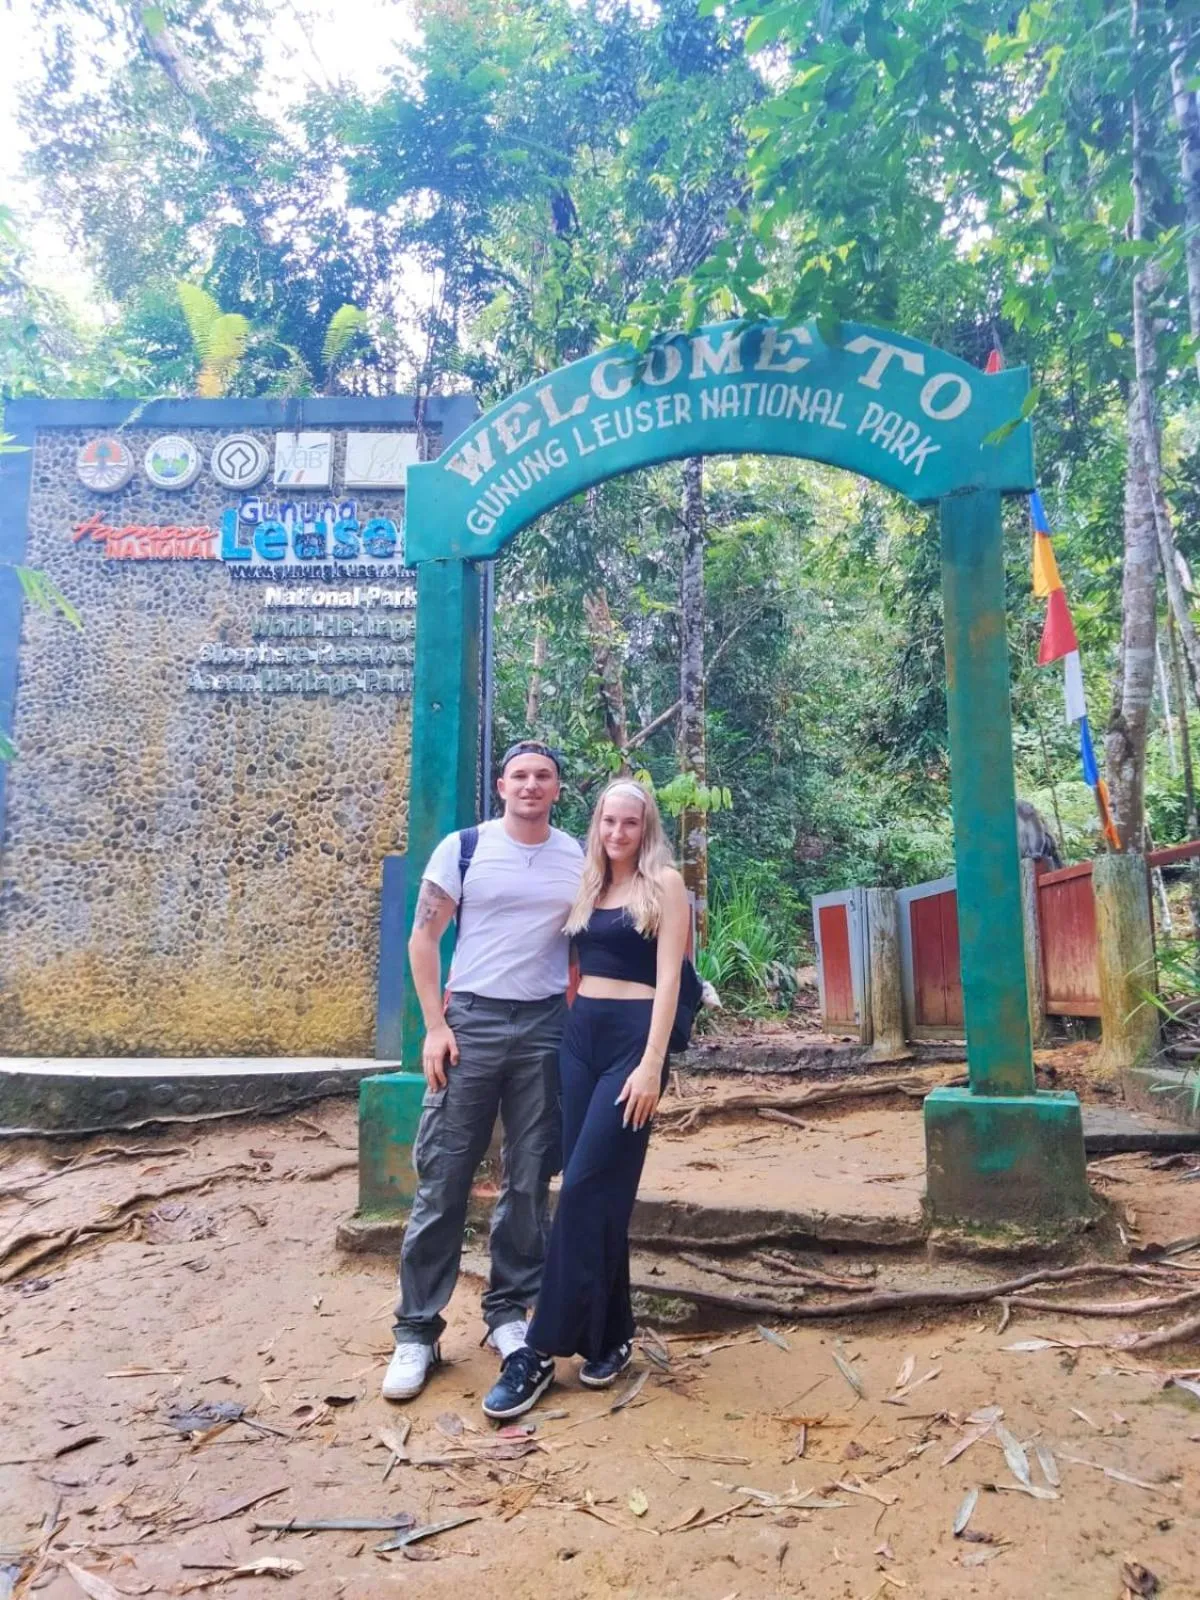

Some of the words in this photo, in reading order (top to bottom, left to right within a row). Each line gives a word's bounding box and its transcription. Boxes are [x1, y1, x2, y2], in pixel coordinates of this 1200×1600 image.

[444, 326, 813, 486] WELCOME
[844, 335, 972, 420] TO
[466, 438, 569, 535] GUNUNG
[572, 392, 692, 457] LEUSER
[700, 383, 847, 430] NATIONAL
[856, 402, 941, 475] PARK
[239, 496, 357, 525] Gunung
[104, 538, 217, 560] NASIONAL
[220, 508, 405, 561] Leuse
[264, 586, 360, 608] National
[250, 614, 316, 637] World
[260, 668, 360, 698] Heritage
